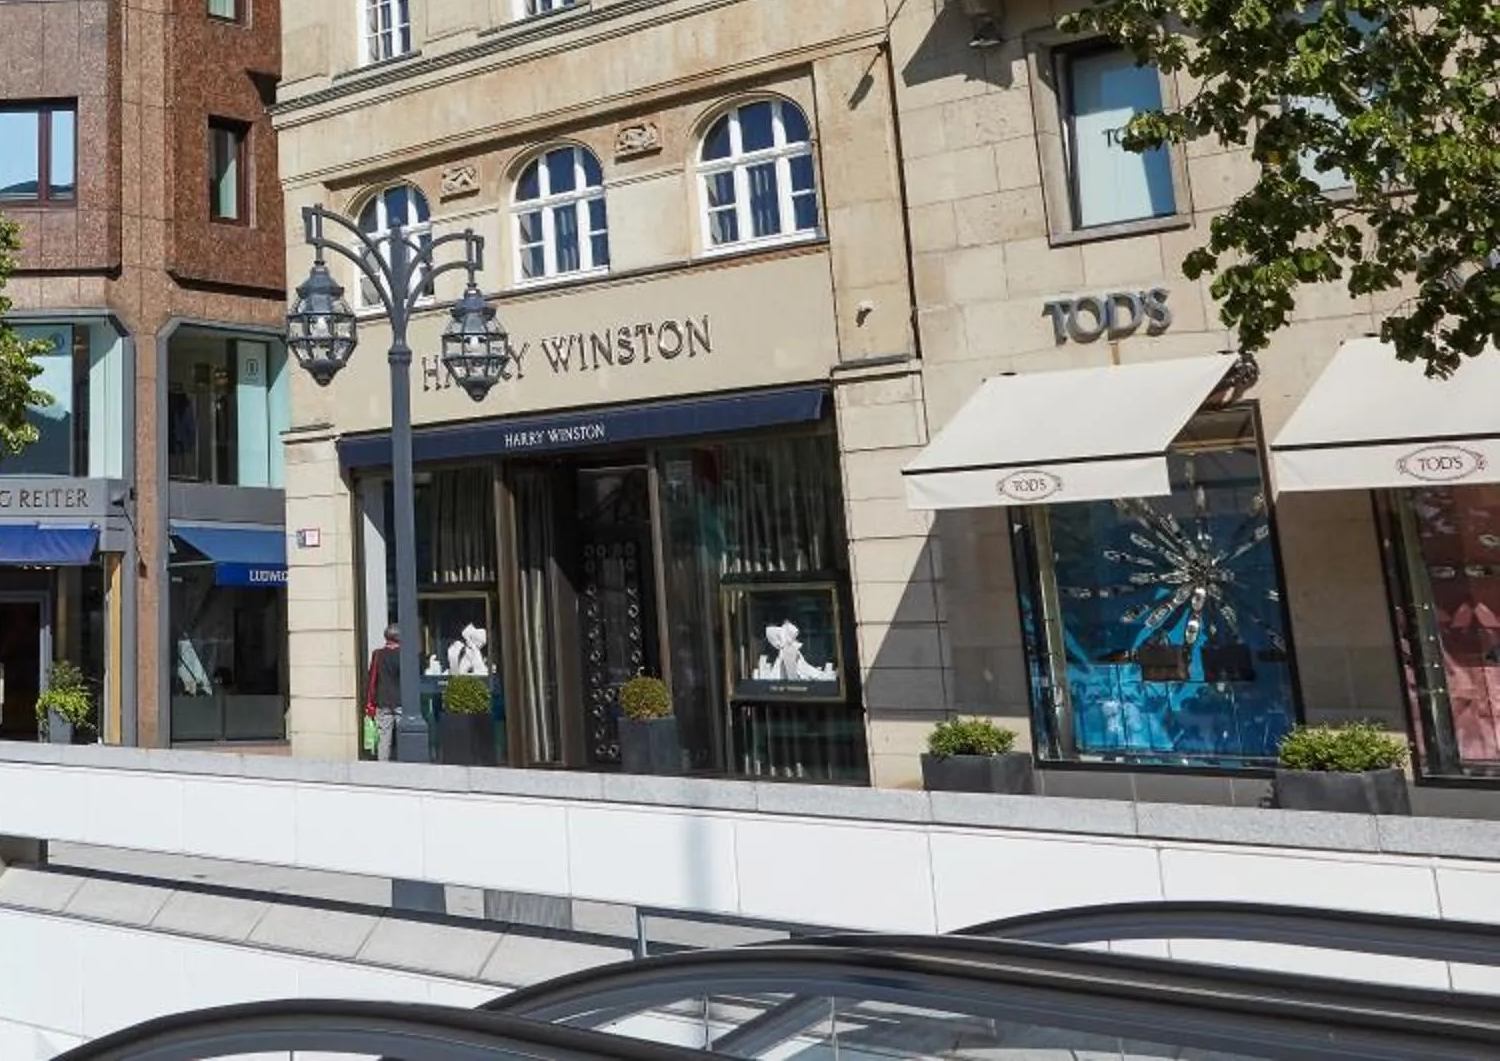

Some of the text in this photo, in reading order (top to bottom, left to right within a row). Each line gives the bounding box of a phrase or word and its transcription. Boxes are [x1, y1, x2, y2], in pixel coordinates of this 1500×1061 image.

[1041, 287, 1173, 347] TOD'S
[541, 314, 713, 375] WINSTON
[505, 422, 605, 448] HARRY WINSTON
[19, 489, 89, 509] REITER
